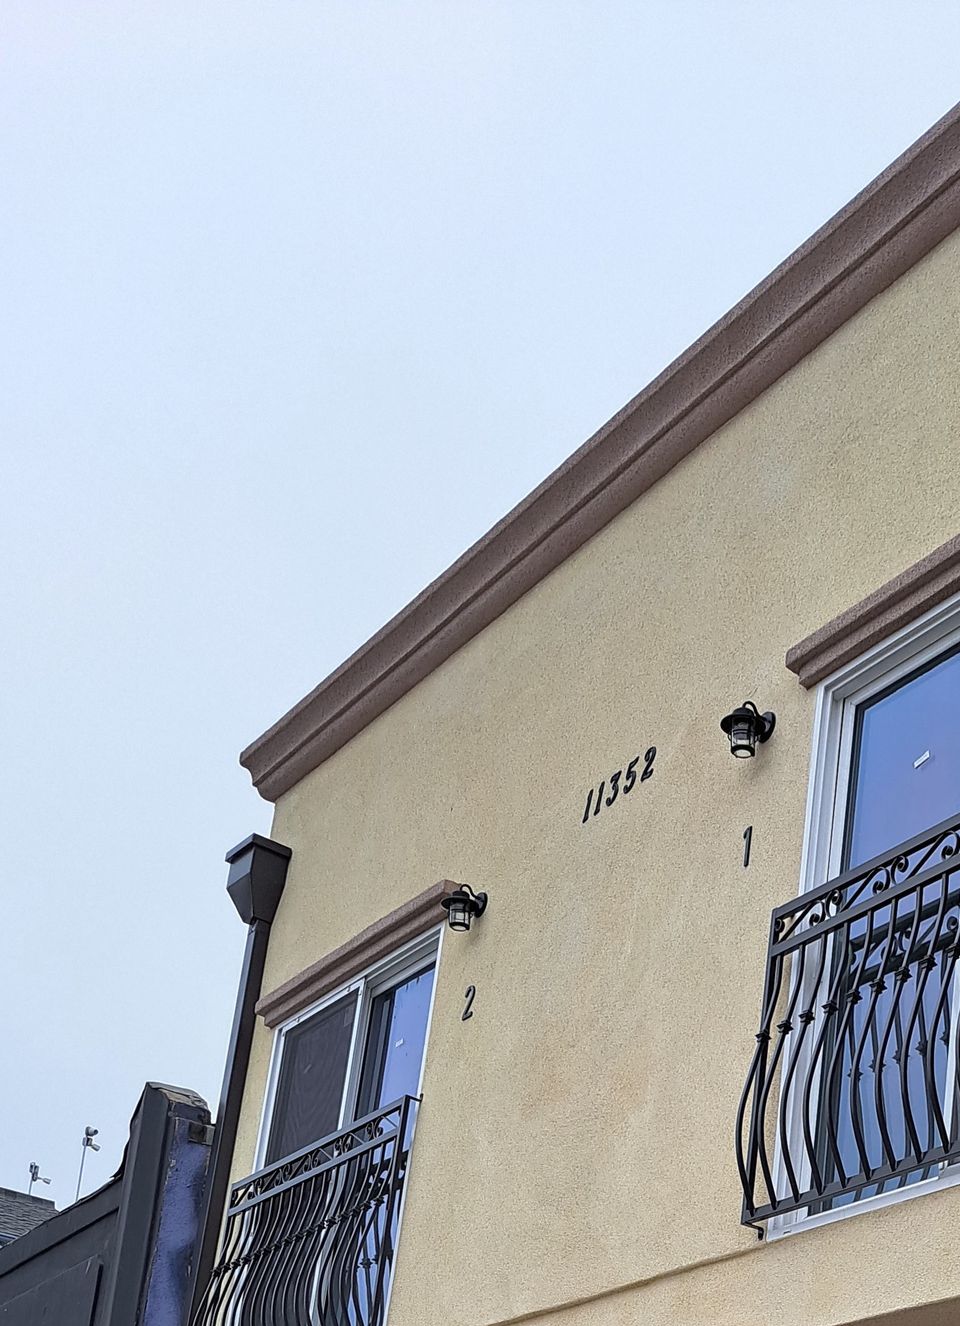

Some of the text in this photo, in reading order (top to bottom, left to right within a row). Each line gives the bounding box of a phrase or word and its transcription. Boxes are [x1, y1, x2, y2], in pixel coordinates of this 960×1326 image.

[581, 746, 657, 824] 11352
[743, 825, 753, 868] 1
[461, 985, 476, 1022] 2
